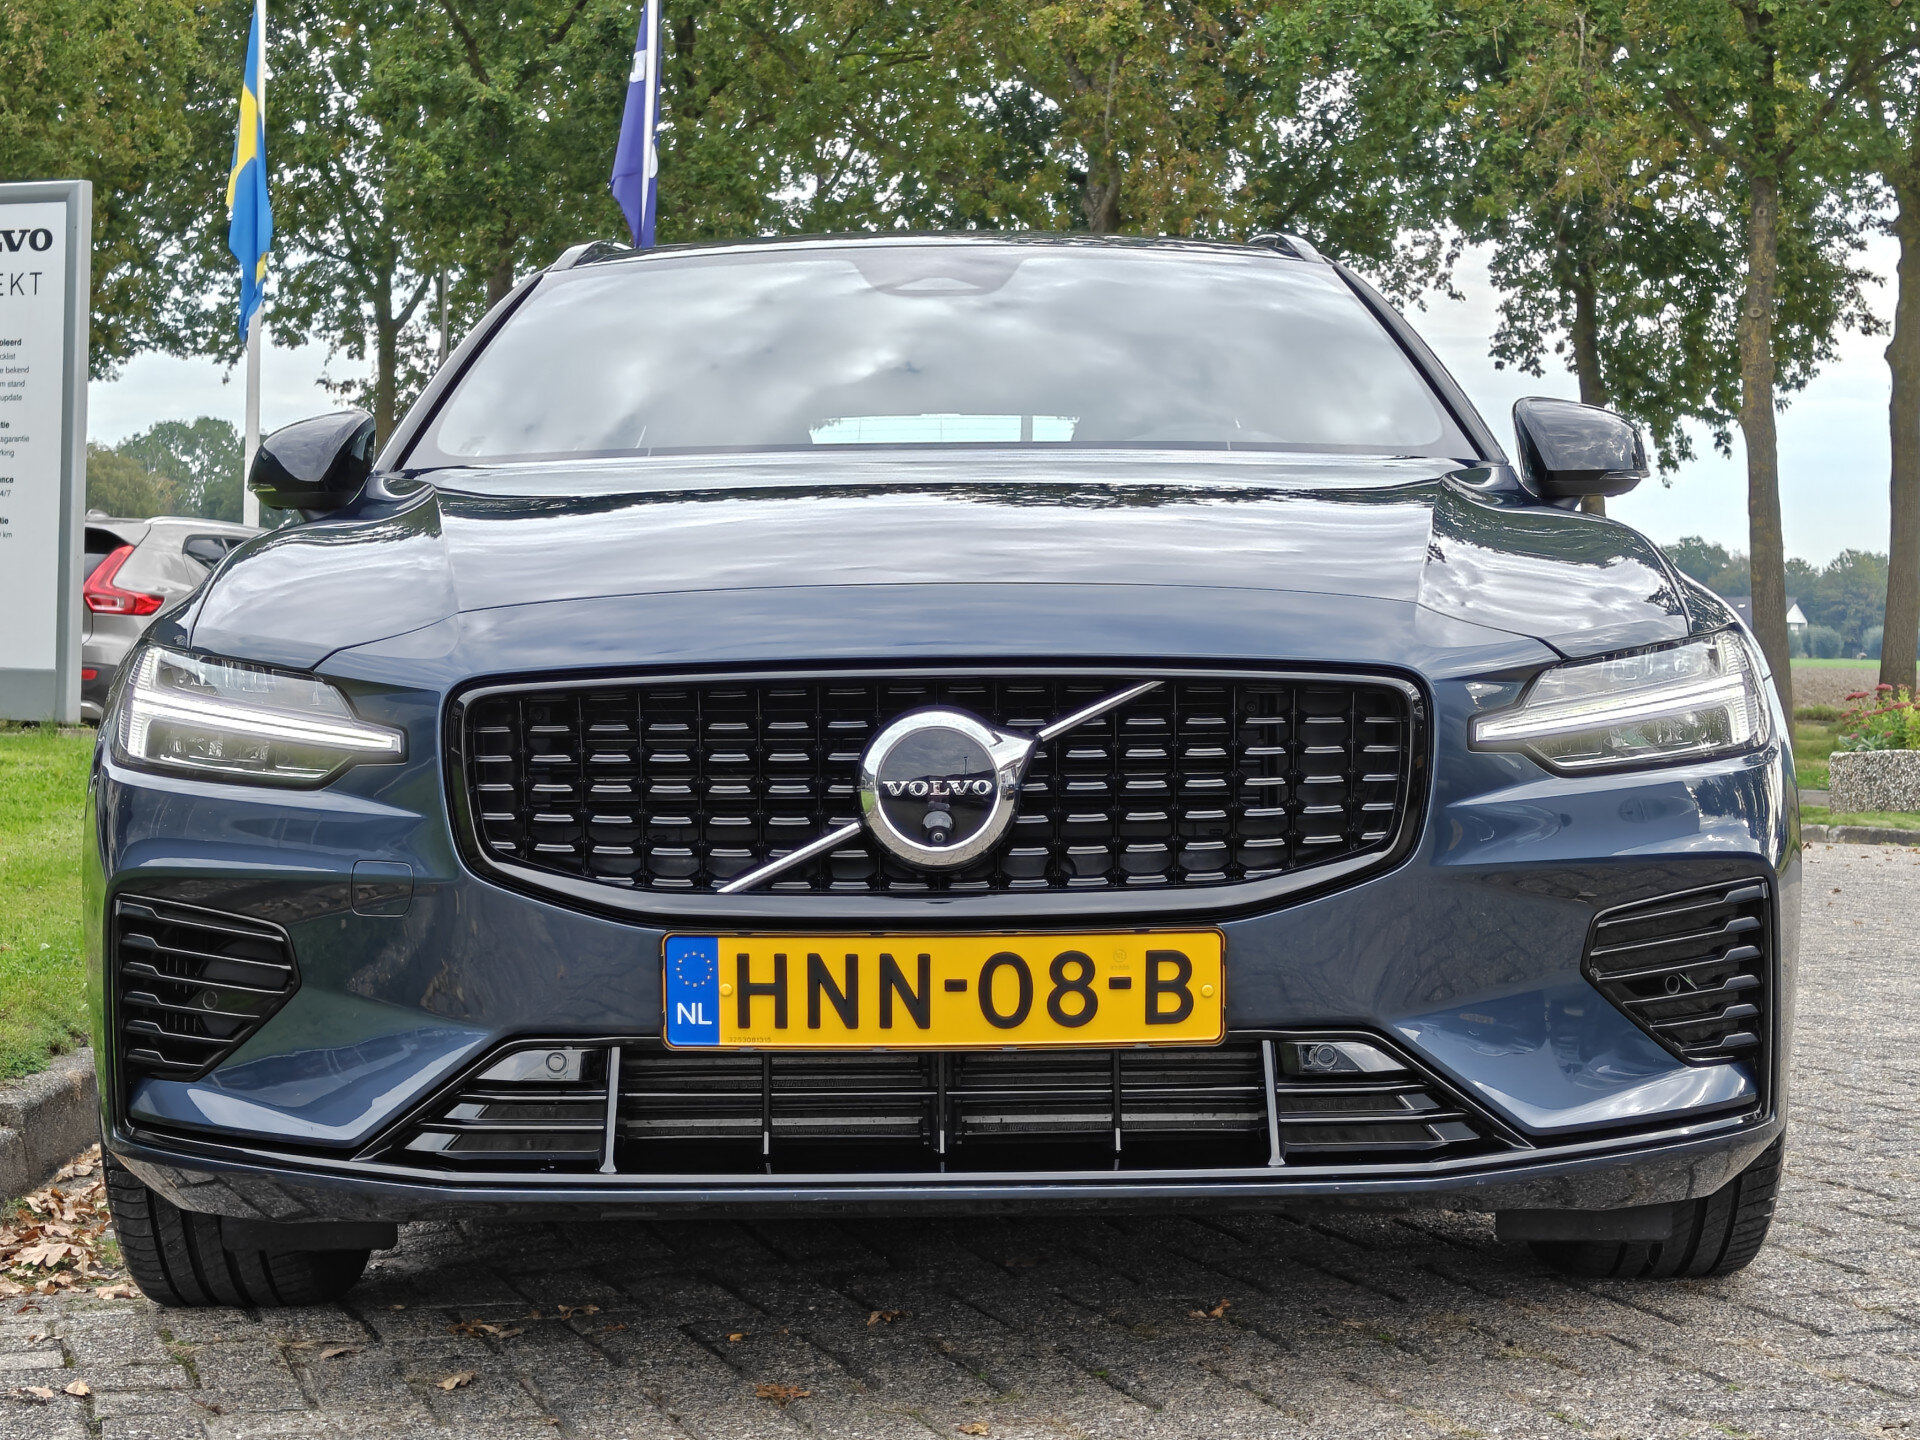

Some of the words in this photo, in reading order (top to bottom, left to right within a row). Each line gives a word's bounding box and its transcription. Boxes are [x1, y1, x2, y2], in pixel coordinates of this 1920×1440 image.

[0, 228, 53, 252] VO
[883, 779, 993, 797] VOLVO
[736, 949, 1195, 1030] HNN-08-B
[676, 1002, 713, 1025] NL
